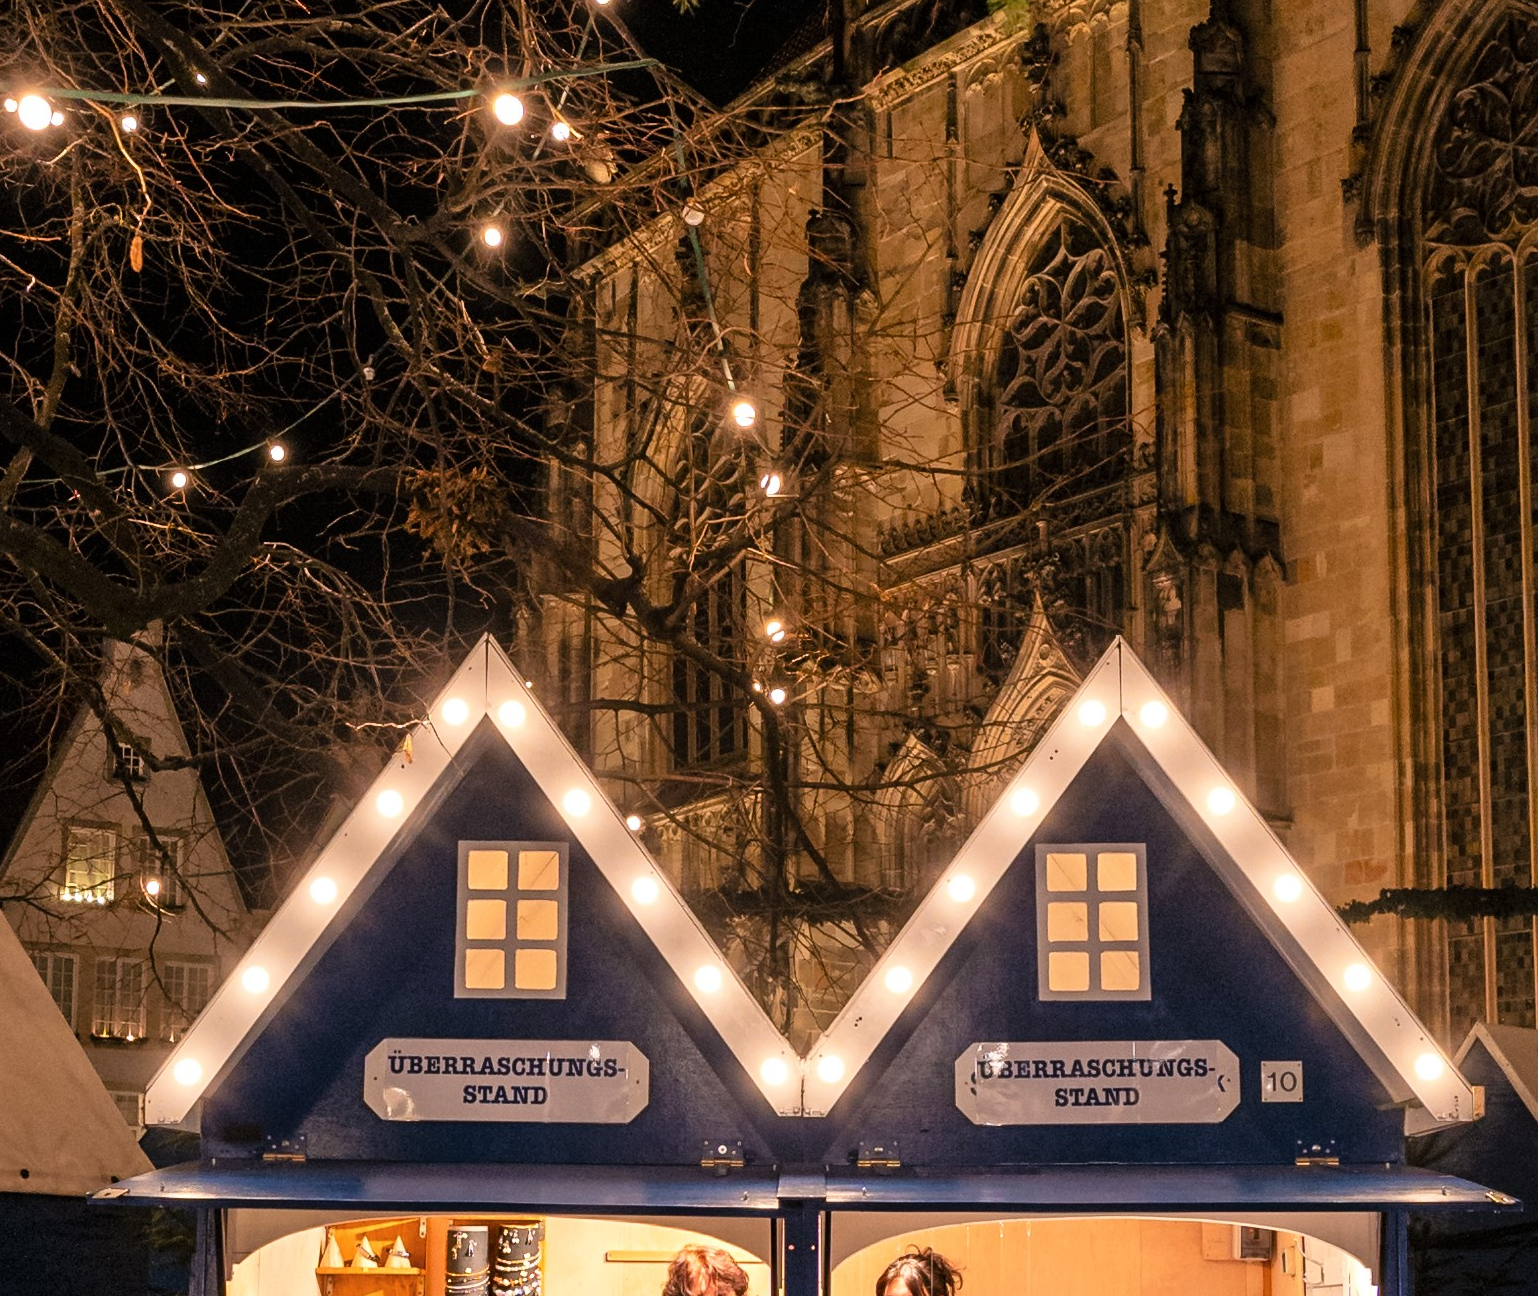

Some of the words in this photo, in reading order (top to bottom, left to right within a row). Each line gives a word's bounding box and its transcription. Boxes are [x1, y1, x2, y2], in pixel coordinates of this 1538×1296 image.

[387, 1049, 626, 1078] ÜBERRASCHUNGS-
[1266, 1071, 1298, 1093] 10
[462, 1085, 549, 1106] STAND
[1054, 1087, 1141, 1107] STAND
